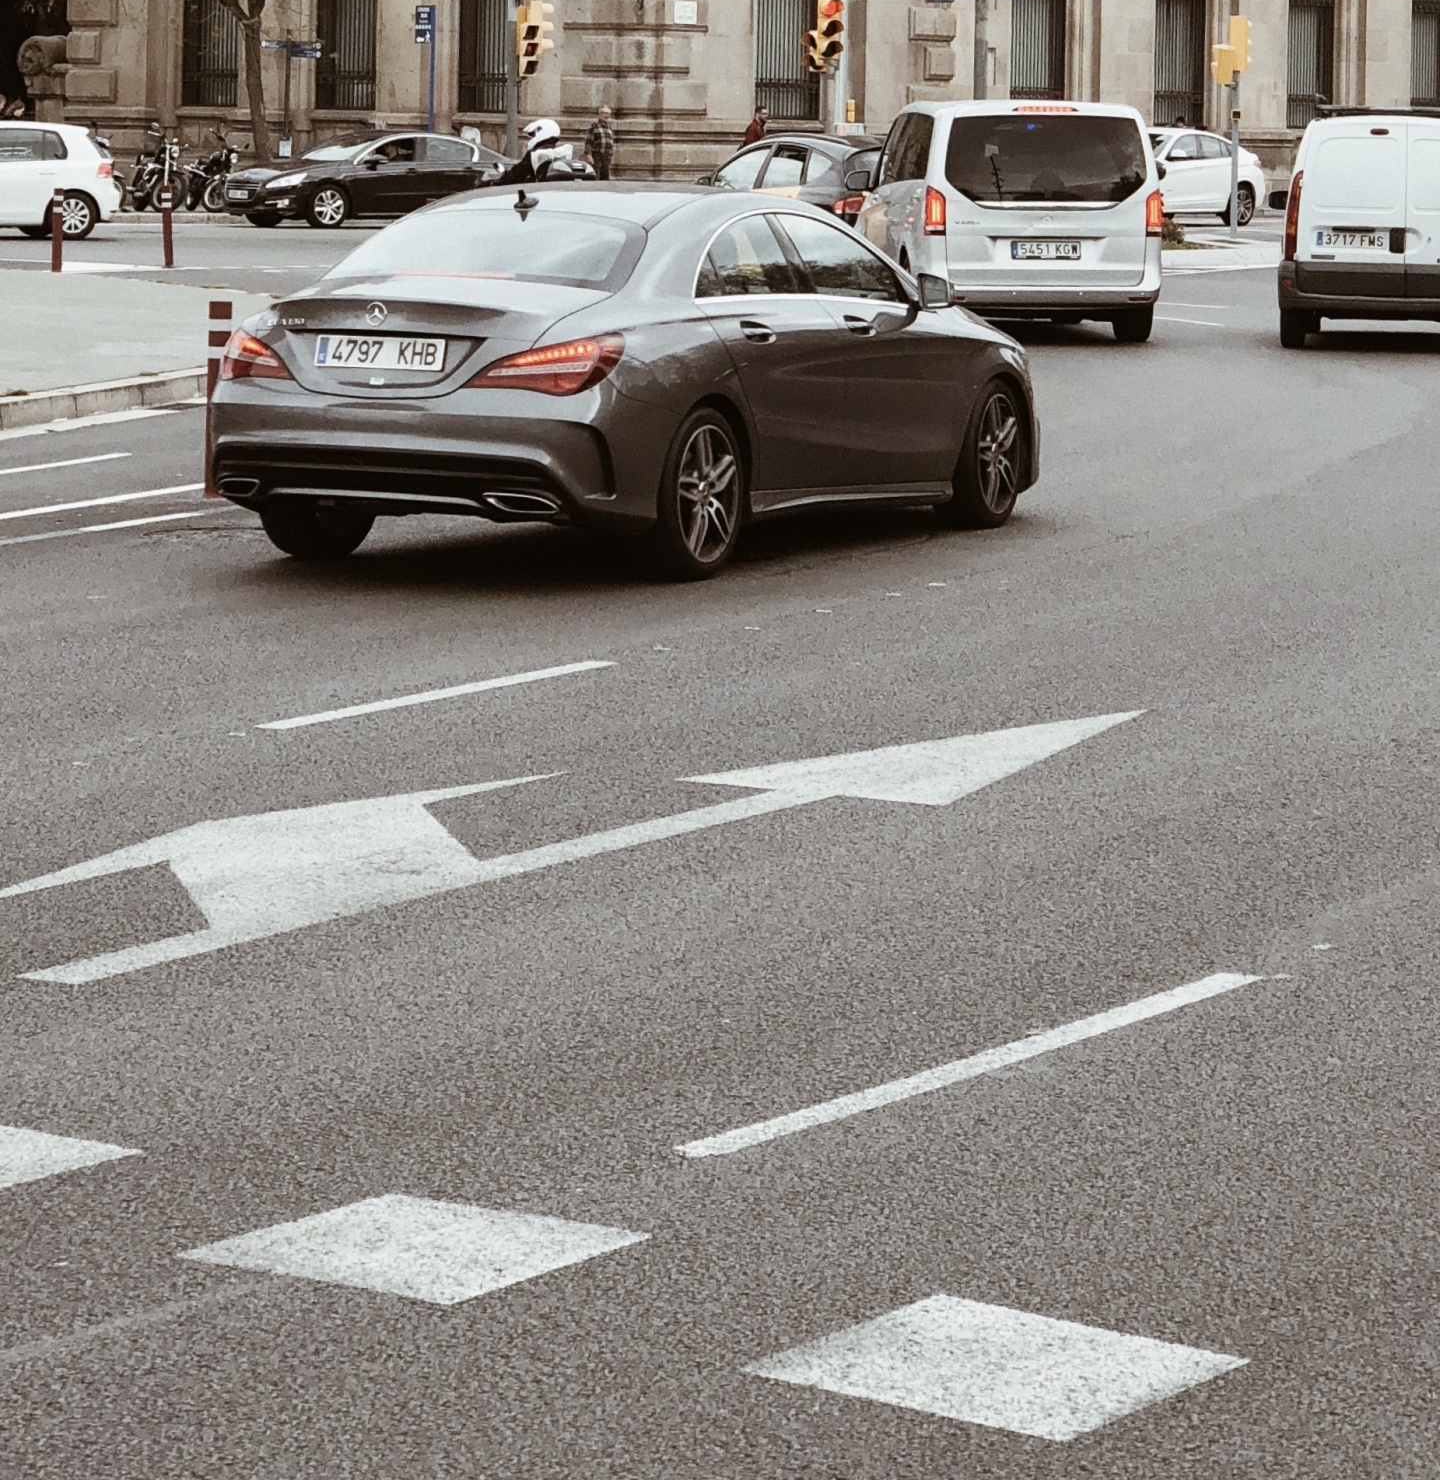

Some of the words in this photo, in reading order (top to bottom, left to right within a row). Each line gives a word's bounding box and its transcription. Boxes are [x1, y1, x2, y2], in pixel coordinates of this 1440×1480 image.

[1325, 233, 1356, 246] 3717
[1360, 234, 1384, 247] FMS
[1020, 243, 1050, 255] 5451
[1055, 243, 1078, 255] KGW
[331, 339, 384, 363] 4797
[397, 340, 437, 366] KHB
